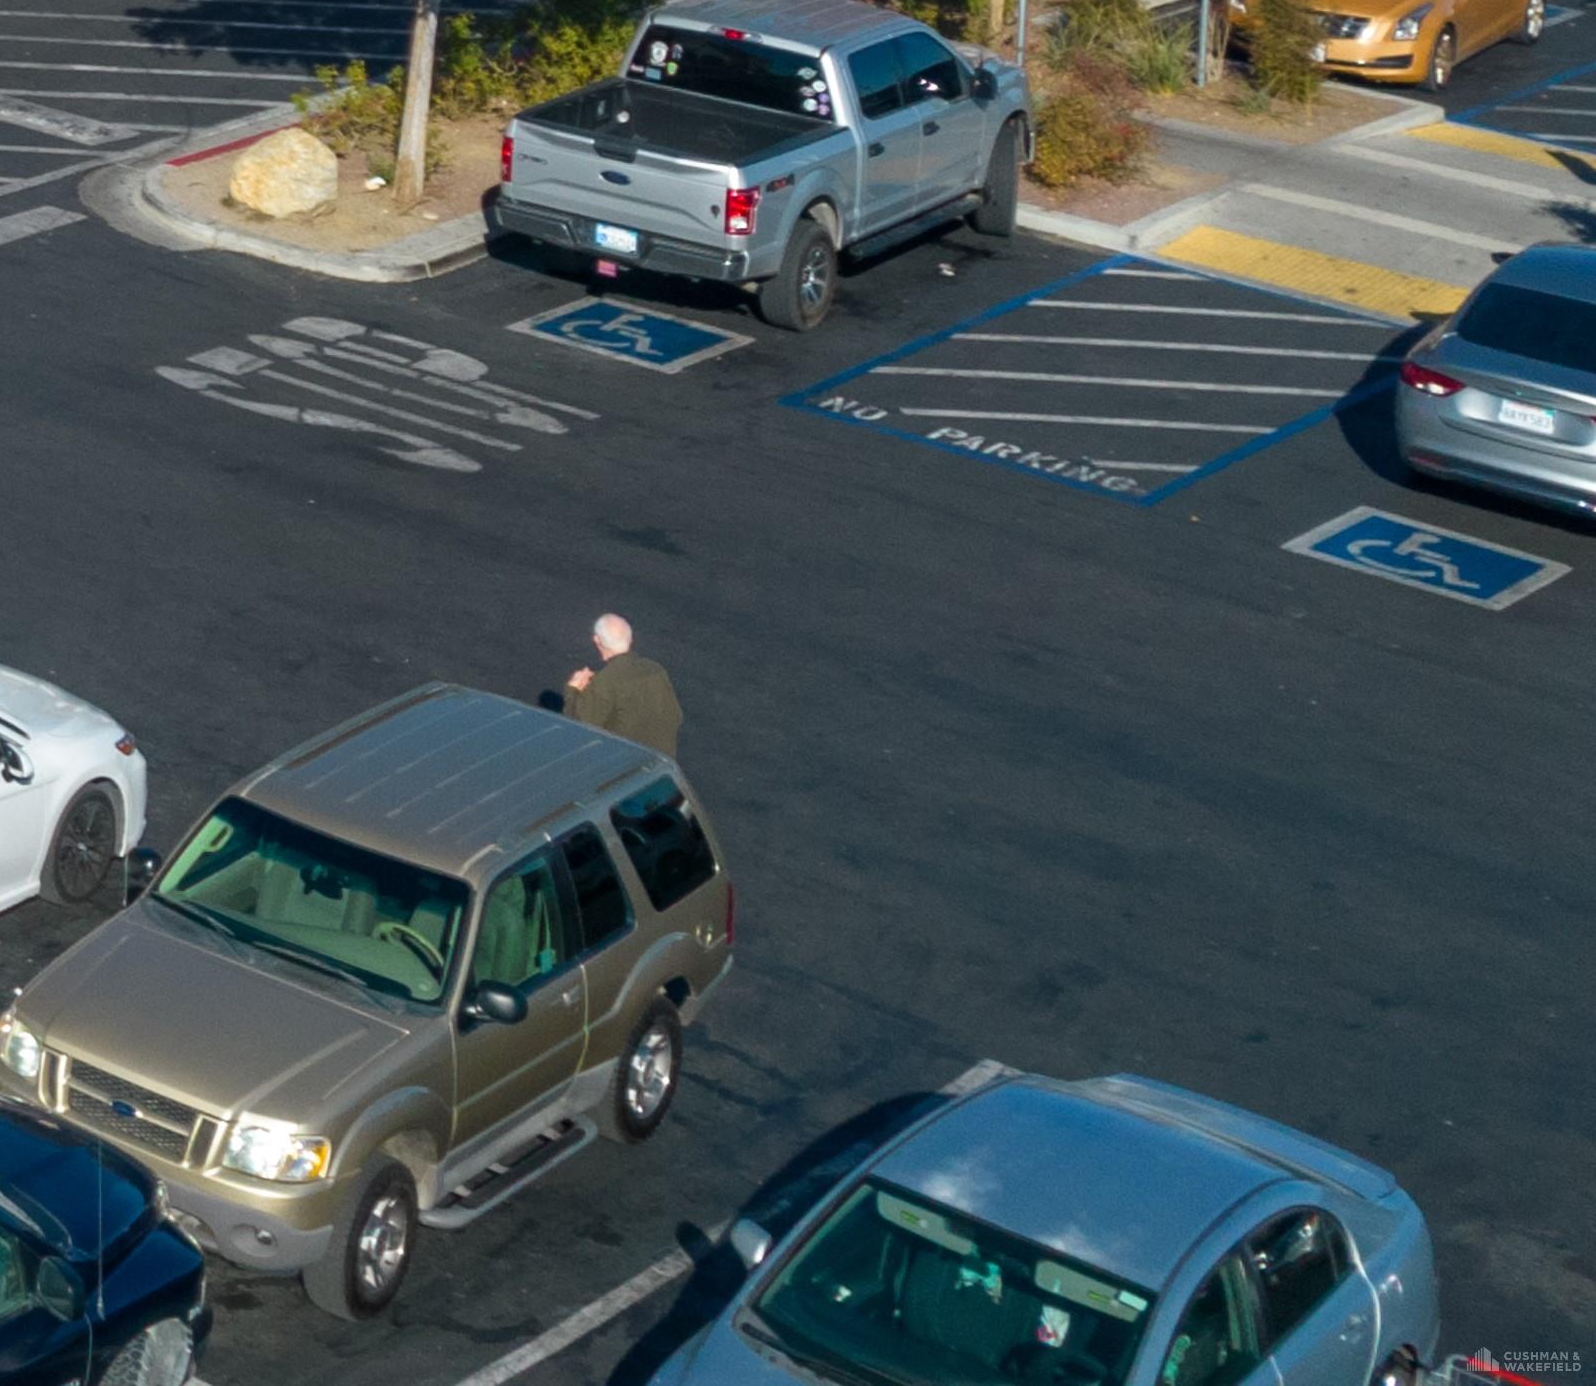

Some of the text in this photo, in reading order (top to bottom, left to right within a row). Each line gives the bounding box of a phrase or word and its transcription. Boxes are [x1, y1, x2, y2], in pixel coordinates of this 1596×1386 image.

[155, 316, 602, 473] STOP
[818, 396, 1143, 492] NO PARKING
